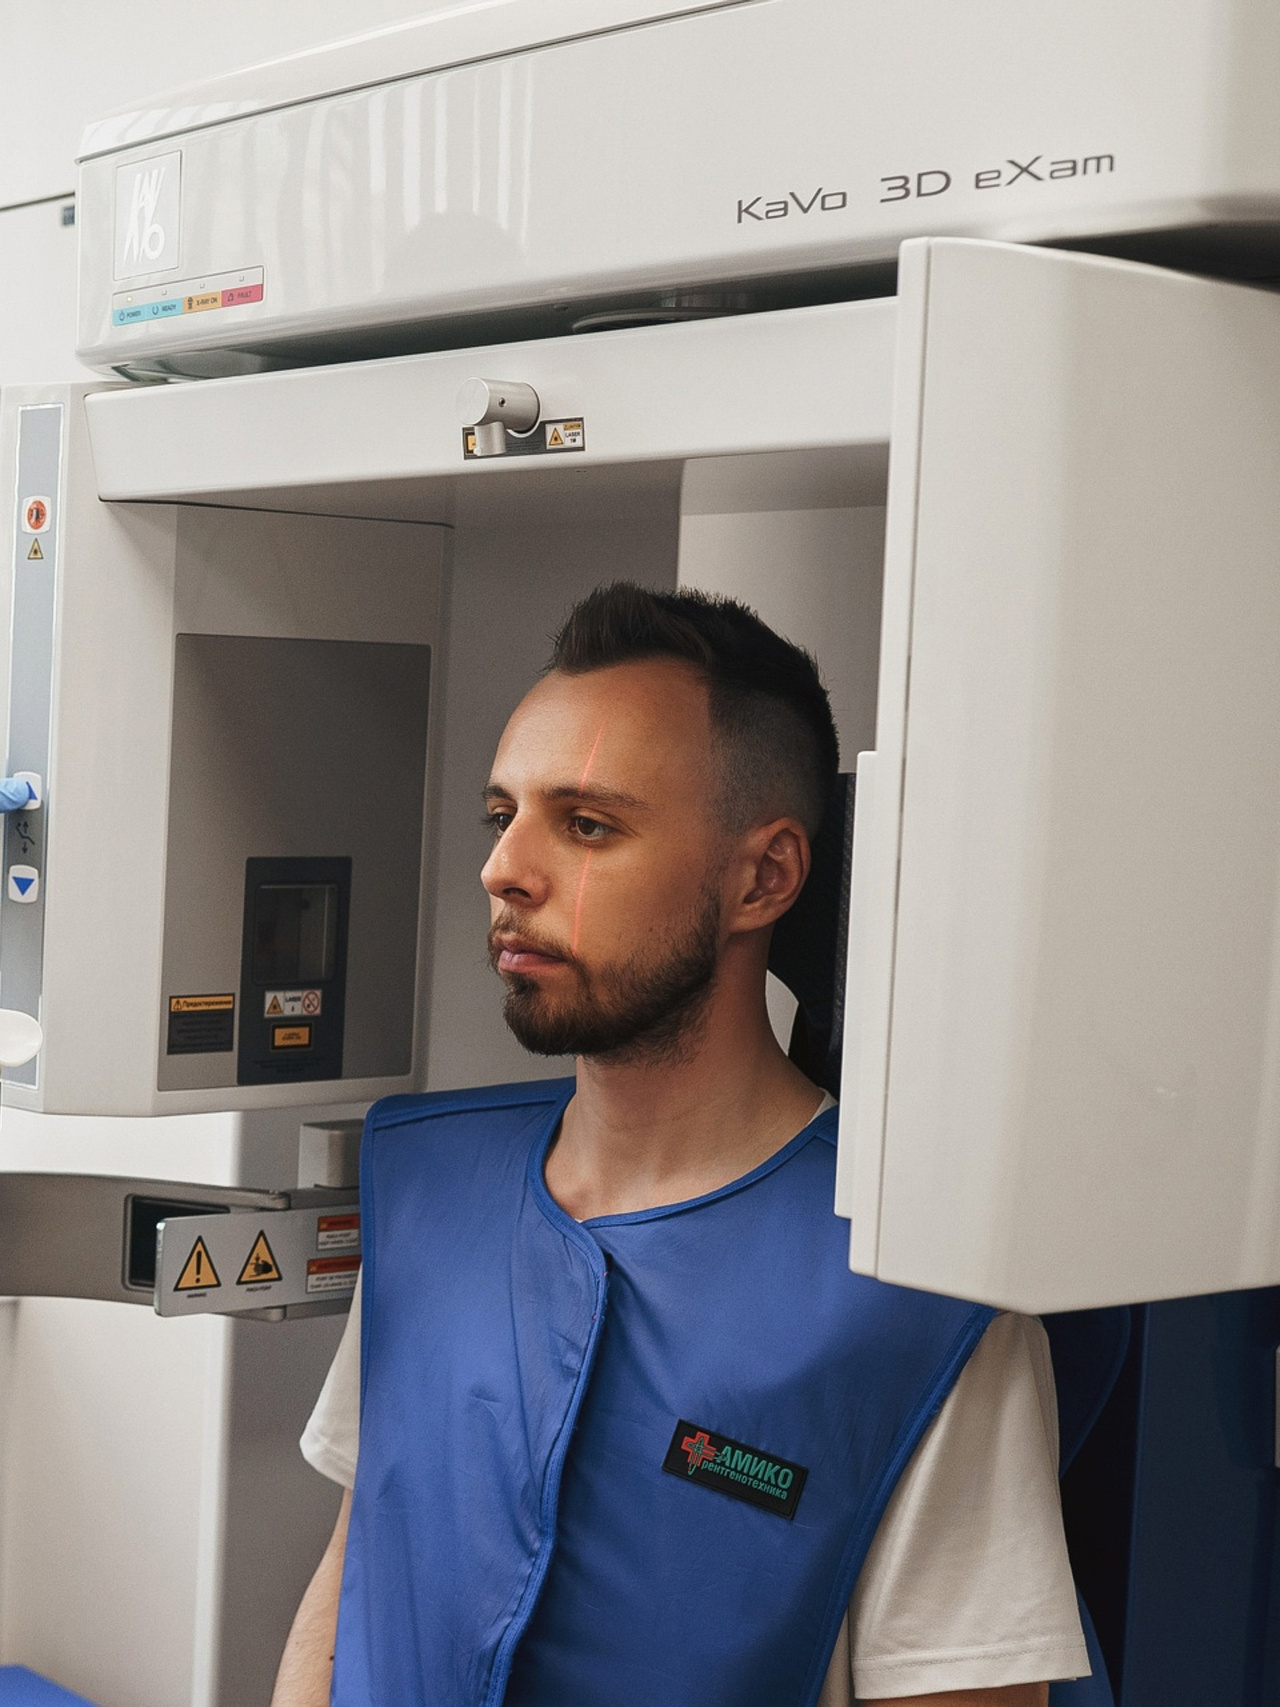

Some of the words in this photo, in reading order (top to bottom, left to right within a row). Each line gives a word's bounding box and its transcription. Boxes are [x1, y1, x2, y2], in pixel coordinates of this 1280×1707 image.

[737, 187, 848, 225] KaVo
[879, 170, 952, 204] 3D
[974, 153, 1115, 190] eXam
[237, 290, 252, 299] FAULT
[126, 310, 141, 318] POWER
[161, 303, 177, 312] READY
[701, 1459, 788, 1501] рентгенотехника
[716, 1445, 794, 1490] АМИКО
